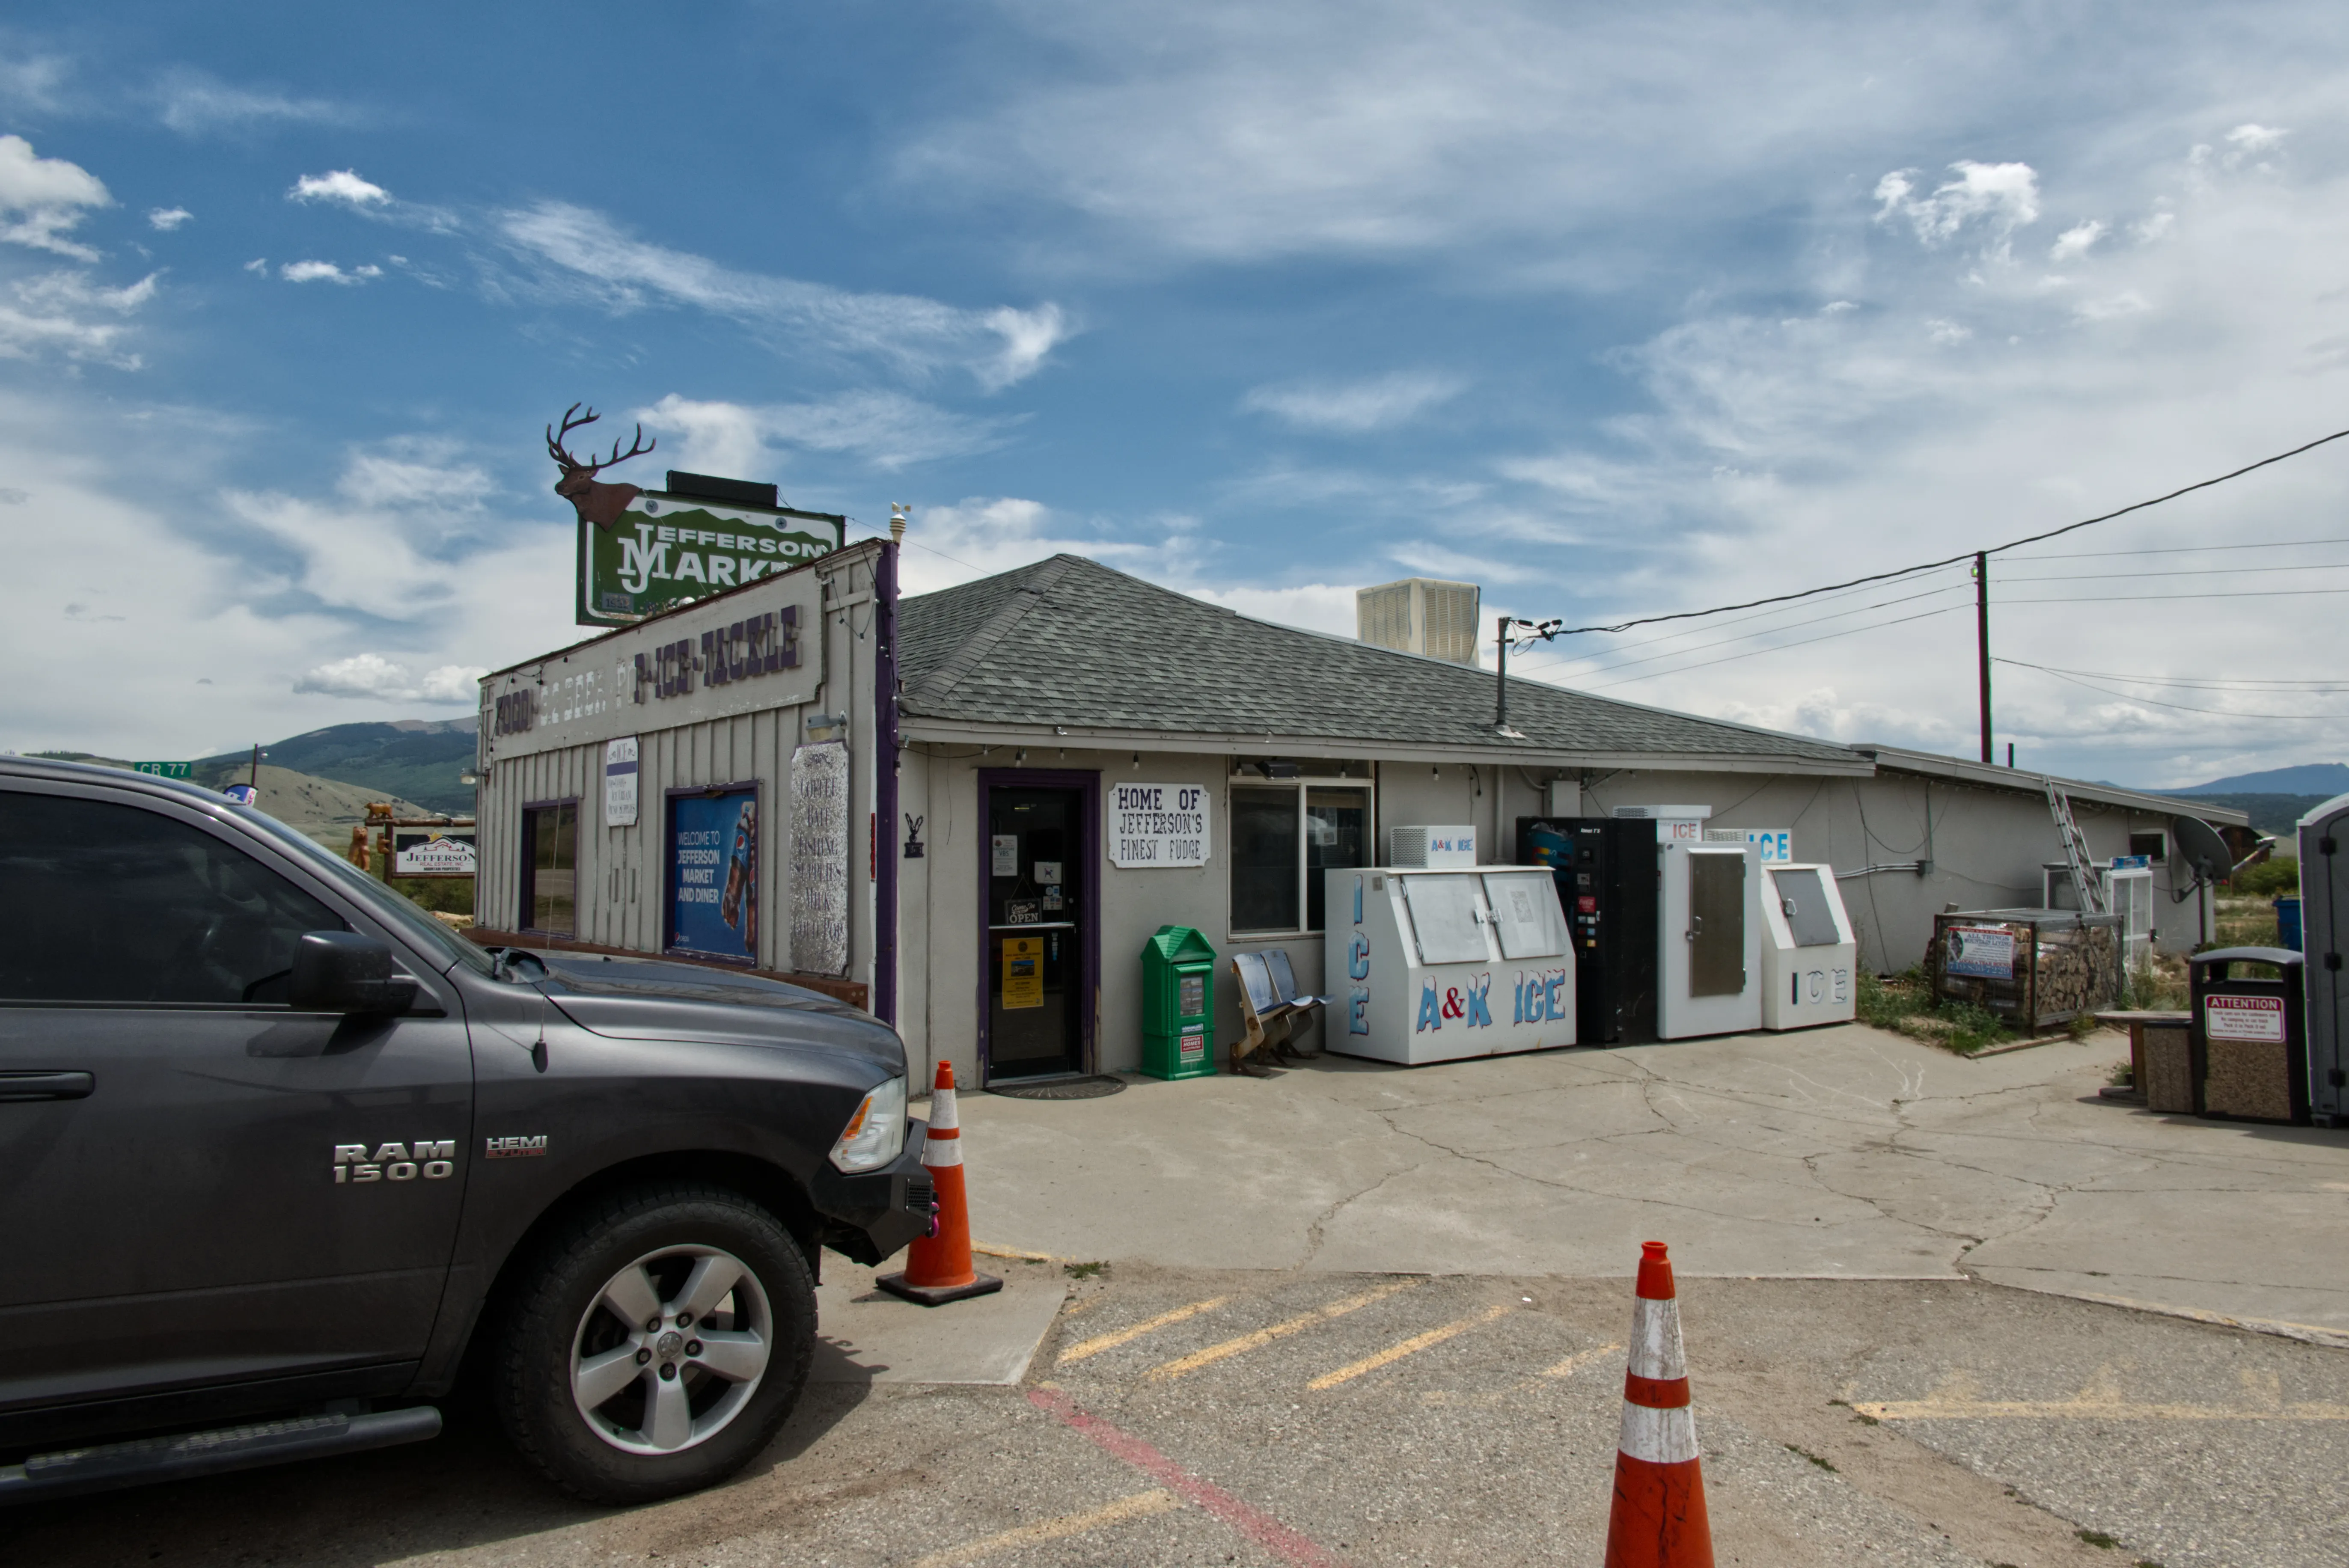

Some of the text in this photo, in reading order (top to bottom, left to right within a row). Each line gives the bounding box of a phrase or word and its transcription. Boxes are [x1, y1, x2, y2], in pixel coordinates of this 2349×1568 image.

[617, 537, 793, 587] MARK
[702, 605, 800, 687] TACKLE
[617, 743, 627, 762] ICE
[140, 763, 187, 776] CR 77
[1118, 788, 1200, 810] HOME OF
[1120, 813, 1202, 834] JEFFERSON'S
[1673, 823, 1696, 838] ICE
[678, 831, 720, 845] WELCOME TO
[1431, 837, 1473, 852] A&K ICE
[1749, 833, 1788, 860] CE
[678, 849, 720, 864] JEFFERSON
[1121, 839, 1200, 860] FINEST FUDGE
[683, 869, 714, 884] MARKET
[678, 888, 719, 903] AND DINER
[1009, 912, 1038, 923] OPEN
[1348, 874, 1369, 1036] ICE
[1792, 968, 1847, 1005] ICE
[1416, 968, 1565, 1034] A&K ICE
[2211, 998, 2278, 1010] ATTENTION
[334, 1140, 455, 1163] RAM
[486, 1135, 547, 1149] HEMI
[334, 1161, 453, 1183] 1500
